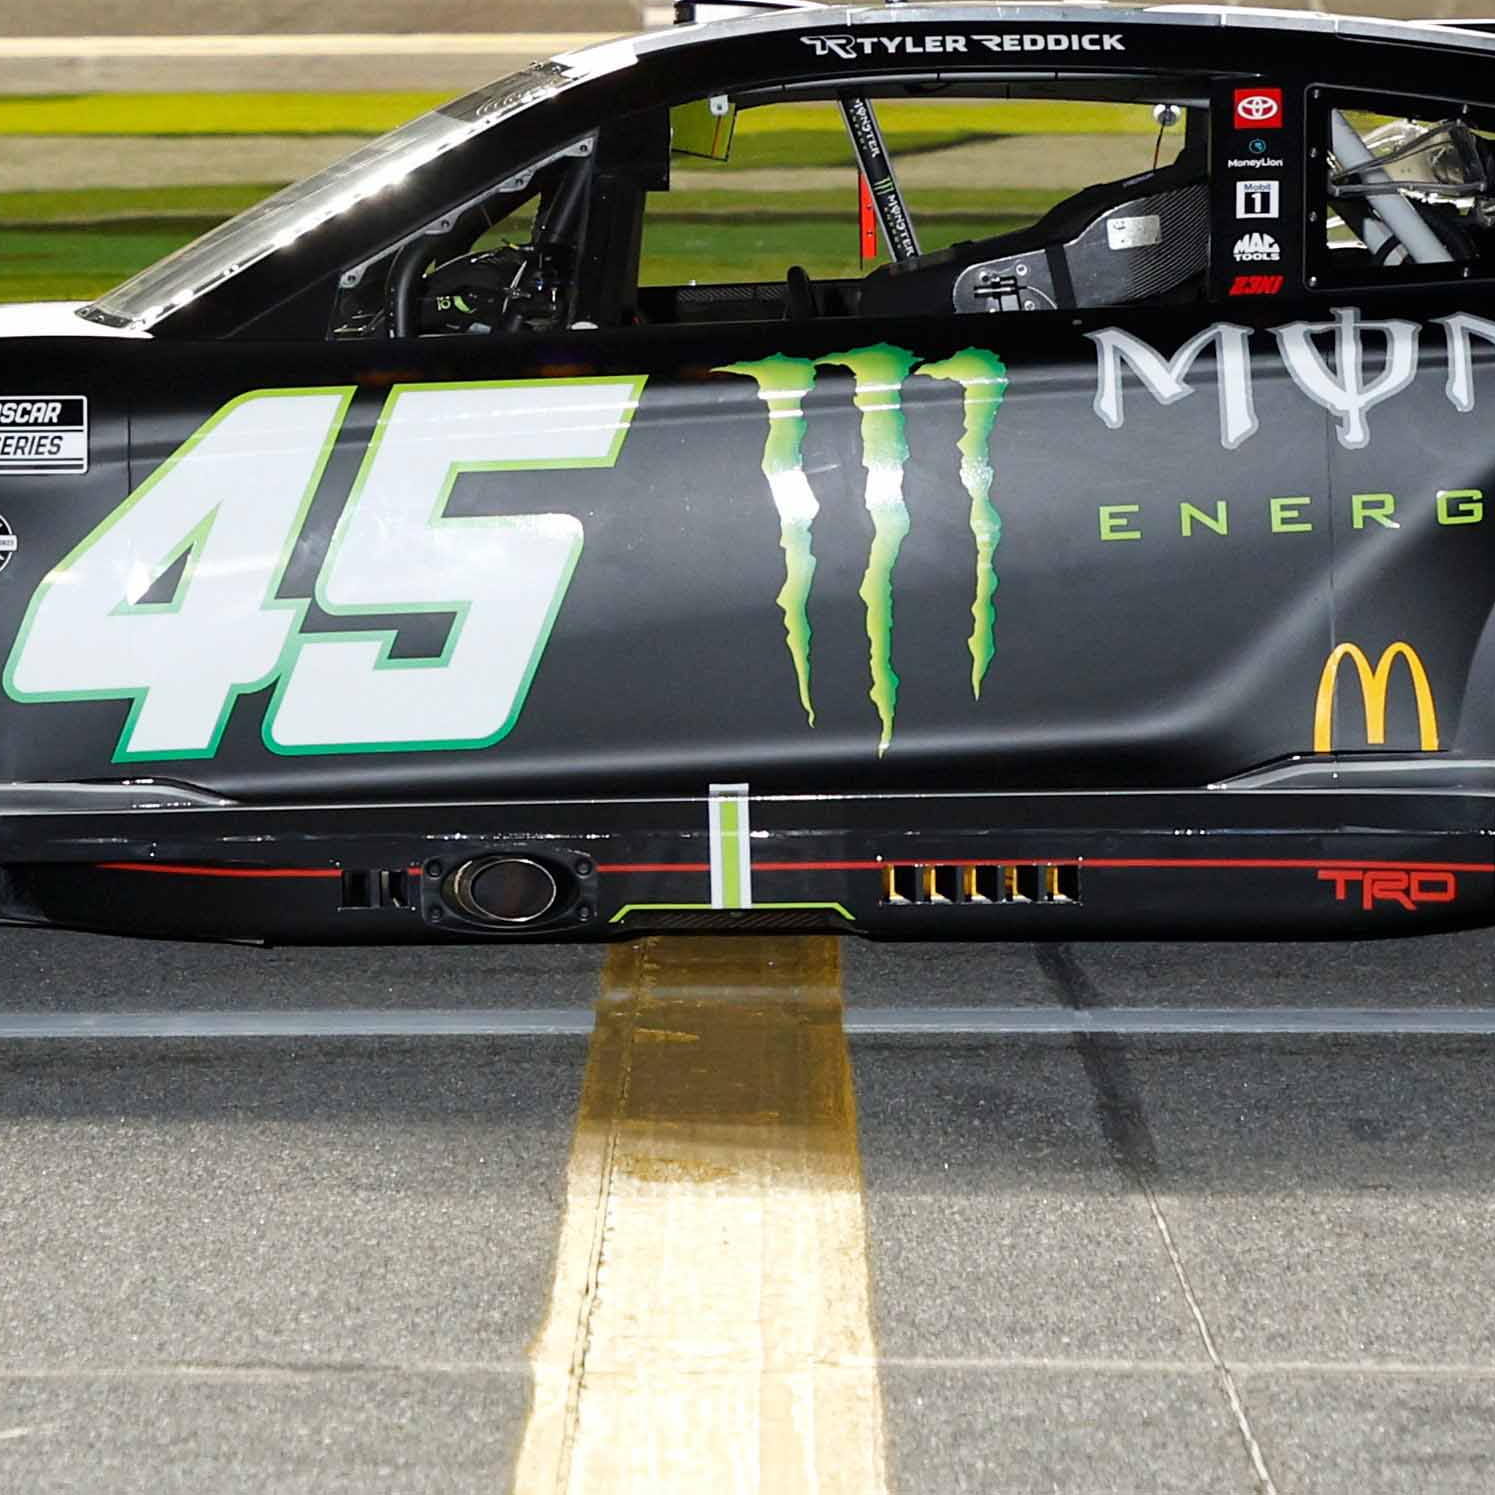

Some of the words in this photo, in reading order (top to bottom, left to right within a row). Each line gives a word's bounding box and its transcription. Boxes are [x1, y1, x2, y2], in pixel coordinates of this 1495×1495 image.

[856, 35, 968, 54] TYLER
[970, 33, 1127, 52] REDDICK
[1227, 157, 1284, 169] MoneyLion
[1244, 183, 1272, 192] Mobil
[1251, 192, 1262, 214] 1
[1233, 232, 1280, 254] MAC
[1234, 253, 1280, 262] TOOLS
[2, 374, 650, 763] 45
[1317, 868, 1457, 911] TRD
